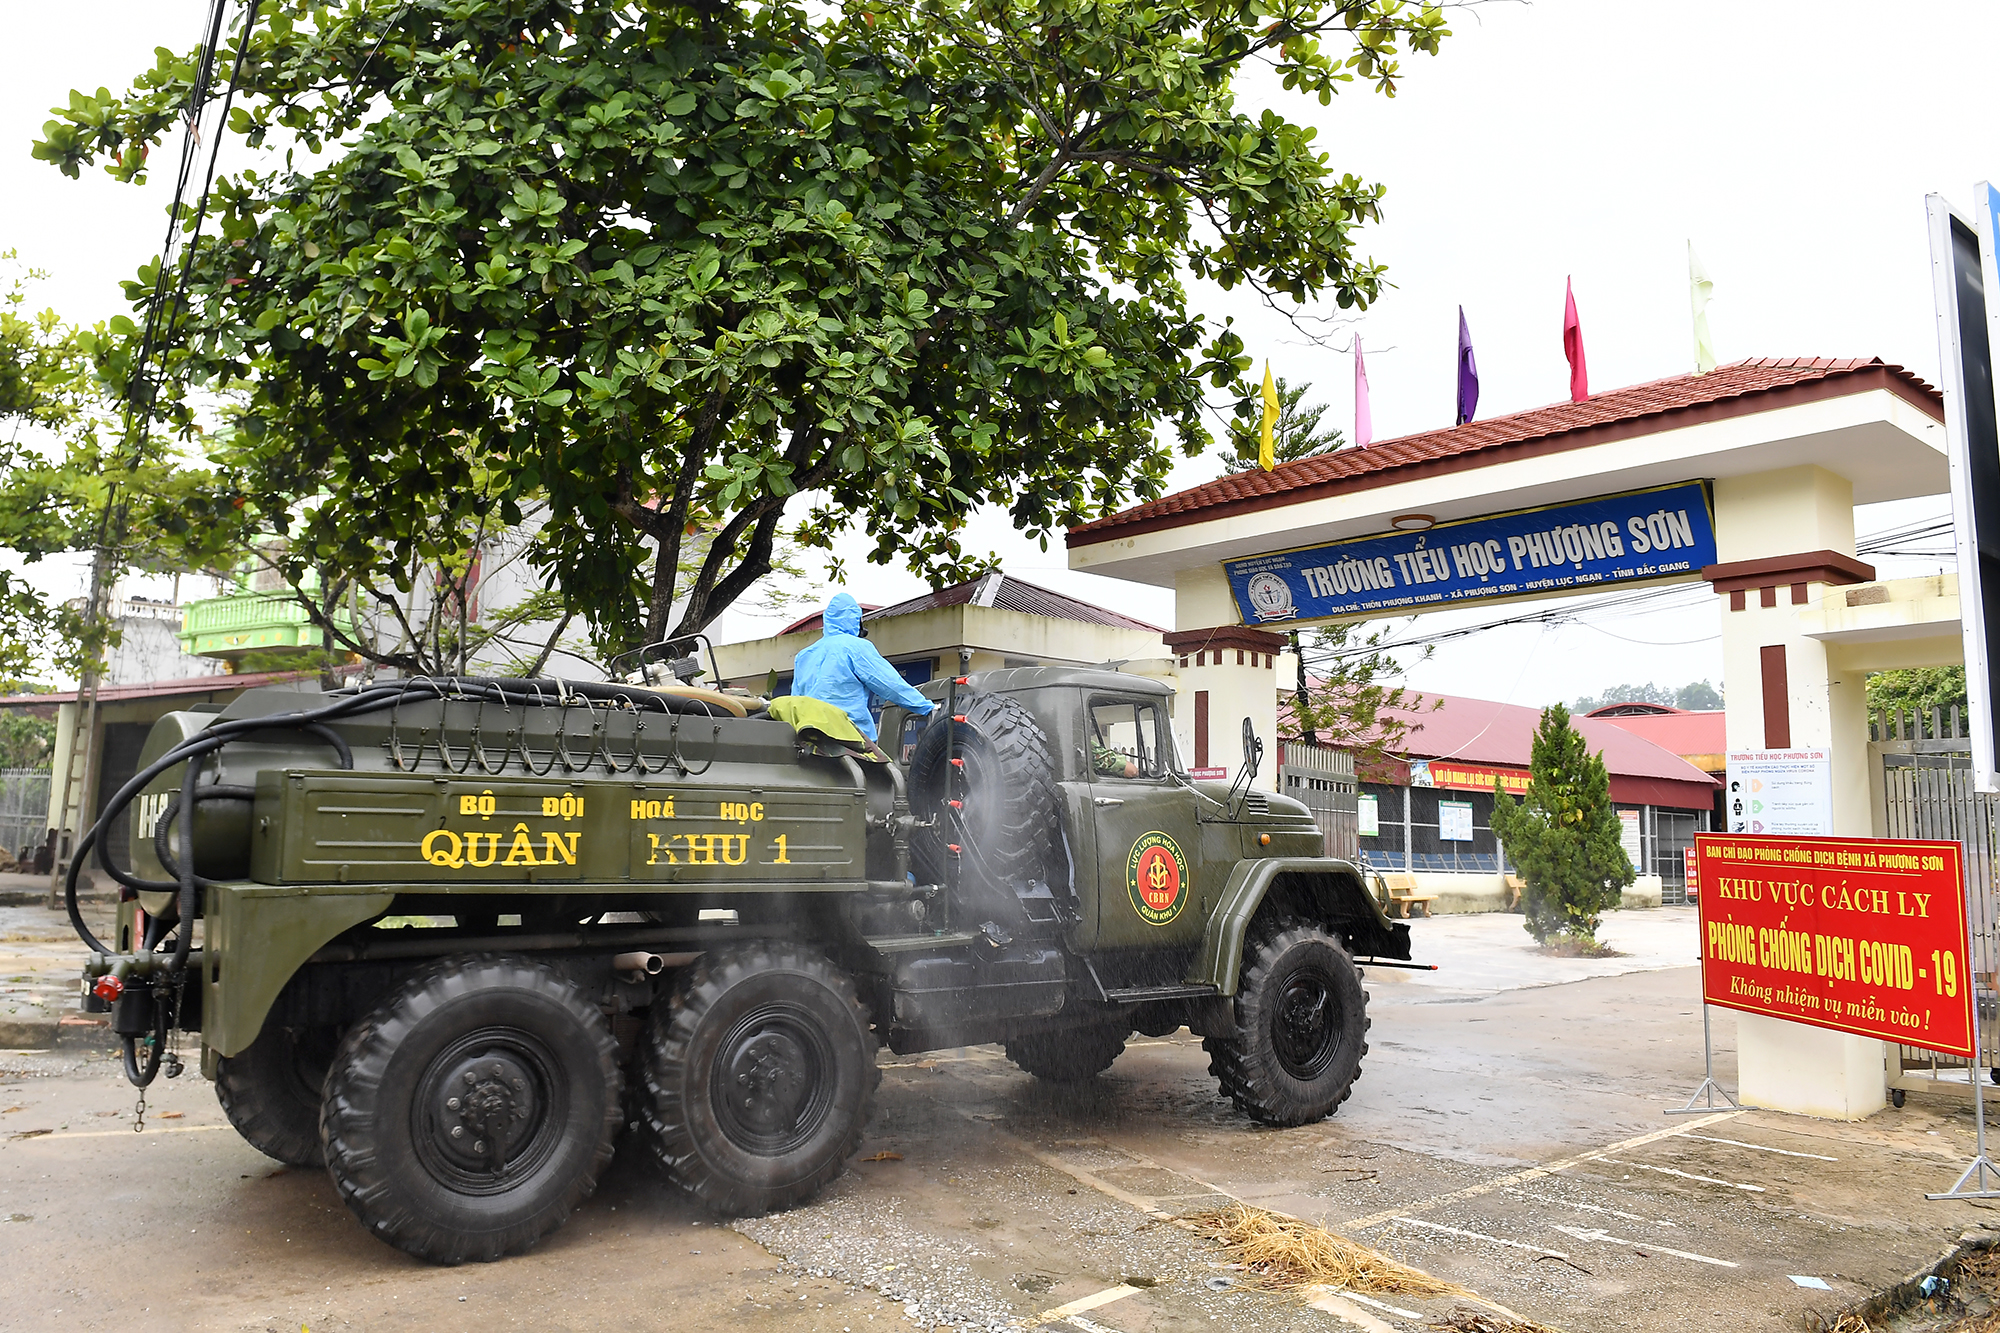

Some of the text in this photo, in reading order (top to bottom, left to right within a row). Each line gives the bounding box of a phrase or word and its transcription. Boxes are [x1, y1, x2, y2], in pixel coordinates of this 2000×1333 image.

[1301, 509, 1694, 598] TRƯỜNG TIỂU HỌC PHƯỢNG SƠN
[1415, 593, 1442, 603] KHANH
[1450, 589, 1463, 598] XÃ
[1465, 586, 1498, 596] PHƯỢNG
[1499, 584, 1517, 592] SƠN
[1526, 578, 1554, 589] HUYỆN
[1556, 577, 1573, 586] LỤC
[1576, 573, 1602, 583] NGẠN
[1612, 567, 1634, 578] TỈNH
[1638, 563, 1656, 575] BẮC
[1659, 561, 1690, 572] GIANG
[460, 790, 764, 824] BỘ ĐỘI HOÁ HỌC
[421, 823, 791, 869] QUÂN KHU 1
[1131, 836, 1184, 871] LỰC LƯỢNG HÓA HỌC
[1706, 843, 1944, 872] BAN CHỈ ĐẠO PHÒNG CHỐNG DỊCH BỆNH XÃ PHƯỢNG SƠN
[1142, 906, 1158, 919] QUÂN
[1160, 910, 1172, 920] KHU
[1149, 892, 1169, 903] CBRN
[1718, 878, 1931, 918] KHU VỰC CÁCH LY
[1708, 914, 1957, 998] PHÒNG CHỐNG DỊCH COVID - 19
[1730, 975, 1772, 1004] Không
[1776, 985, 1820, 1012] nhiệm
[1824, 997, 1842, 1019] vụ
[1846, 996, 1886, 1022] miễn
[1890, 1009, 1920, 1029] vào
